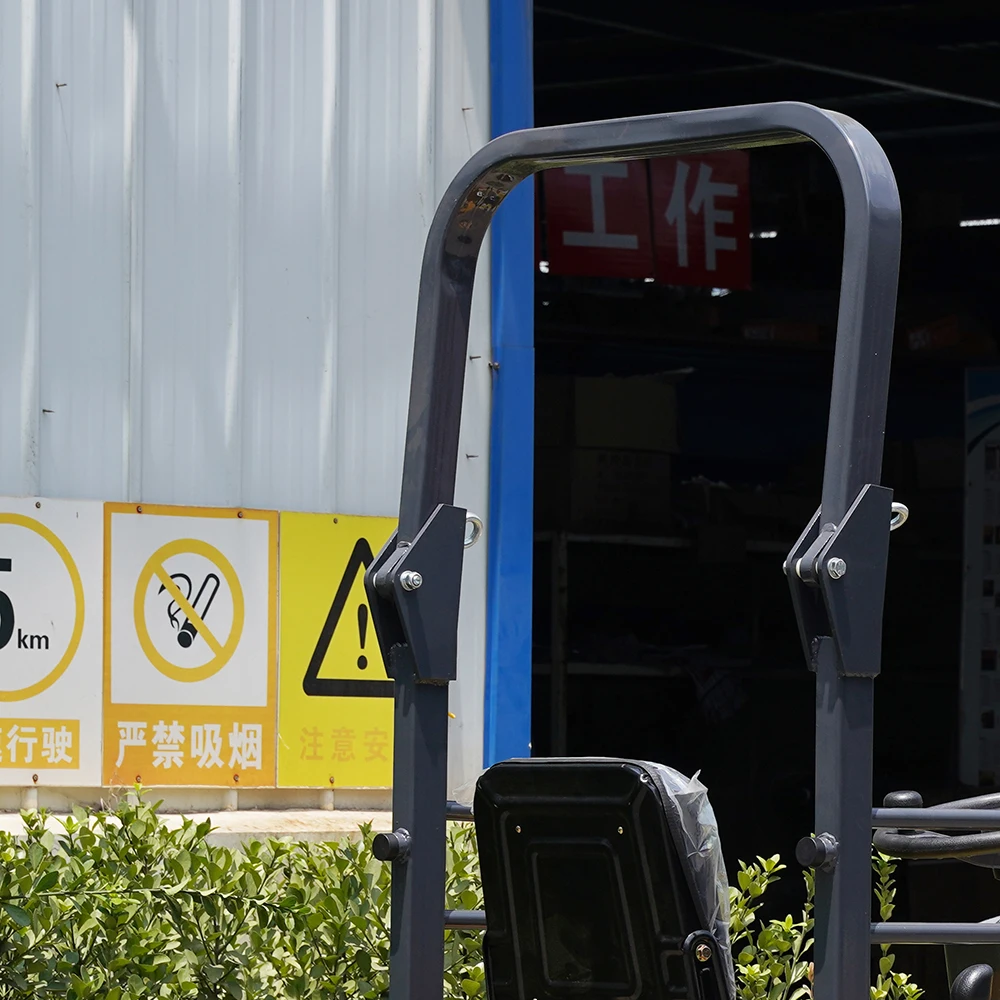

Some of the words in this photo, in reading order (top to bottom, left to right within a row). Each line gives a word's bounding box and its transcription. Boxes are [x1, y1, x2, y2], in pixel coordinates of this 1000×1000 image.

[562, 160, 739, 271] 工作
[0, 724, 73, 764] 行驶
[116, 720, 263, 770] 严禁吸烟
[300, 726, 389, 763] 注意安
